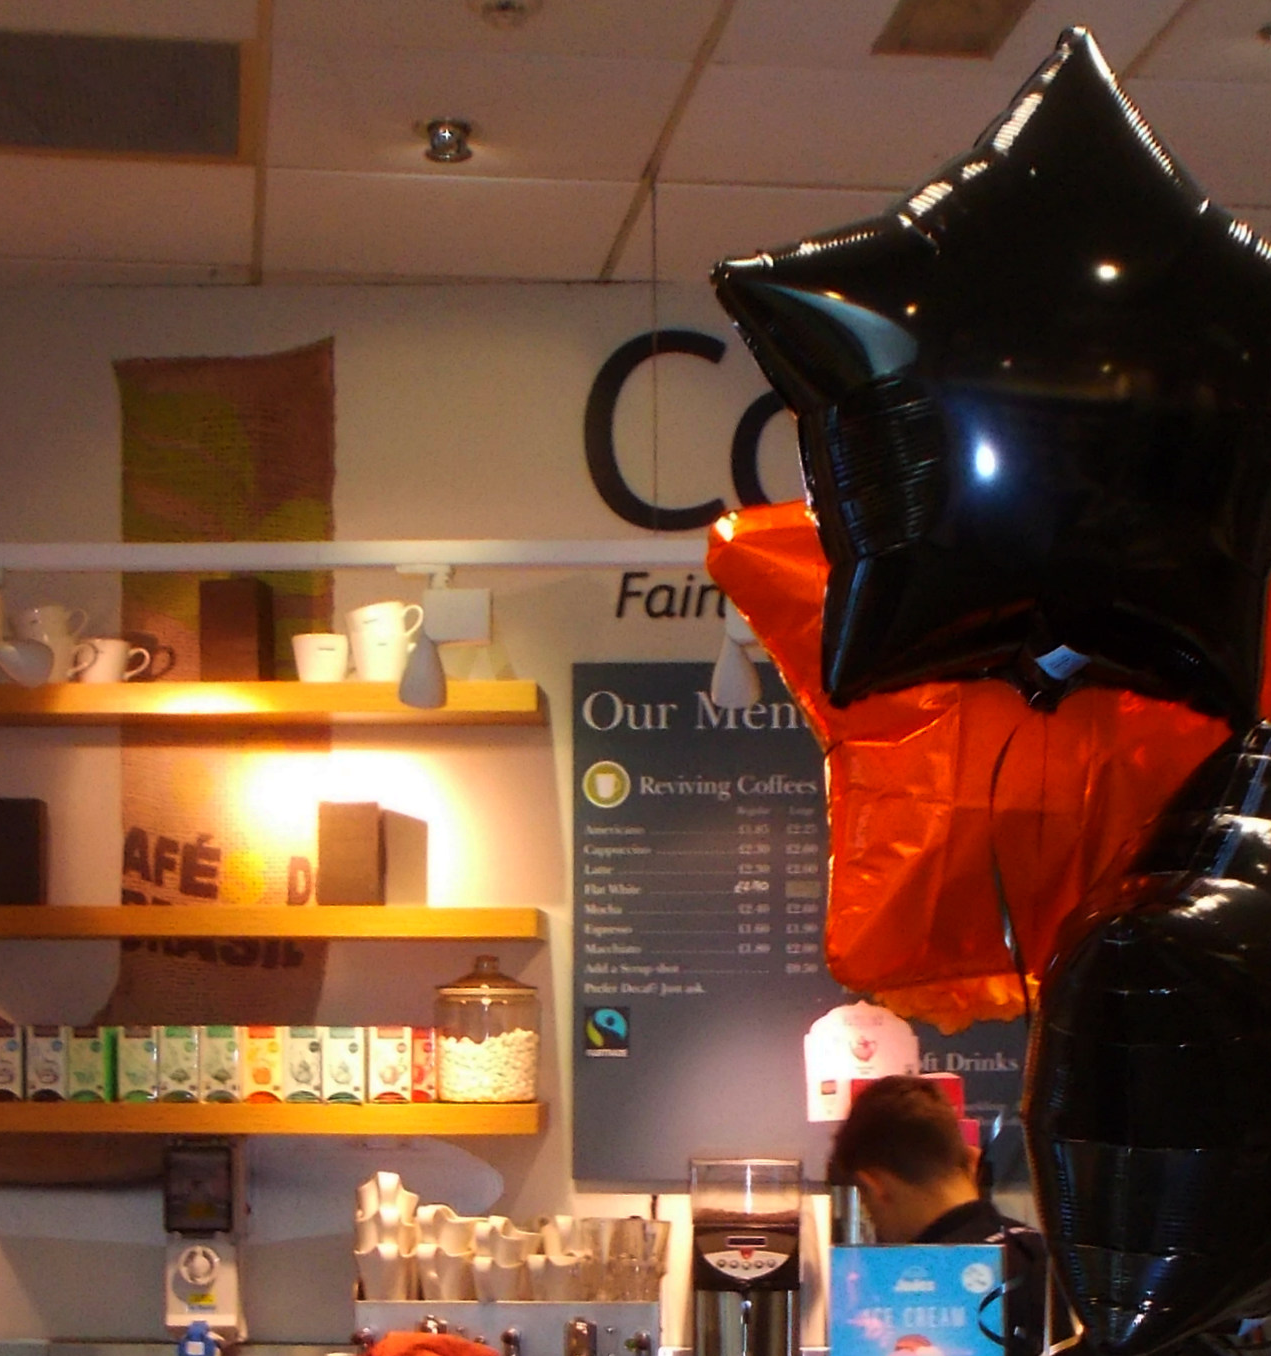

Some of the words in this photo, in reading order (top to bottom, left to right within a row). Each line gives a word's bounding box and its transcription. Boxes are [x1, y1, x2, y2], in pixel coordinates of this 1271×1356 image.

[583, 690, 678, 731] Our
[694, 690, 810, 731] Men
[639, 775, 731, 800] Reviving
[737, 774, 818, 796] Coffees
[946, 1052, 1020, 1072] Drinks
[902, 1306, 967, 1328] CREAM
